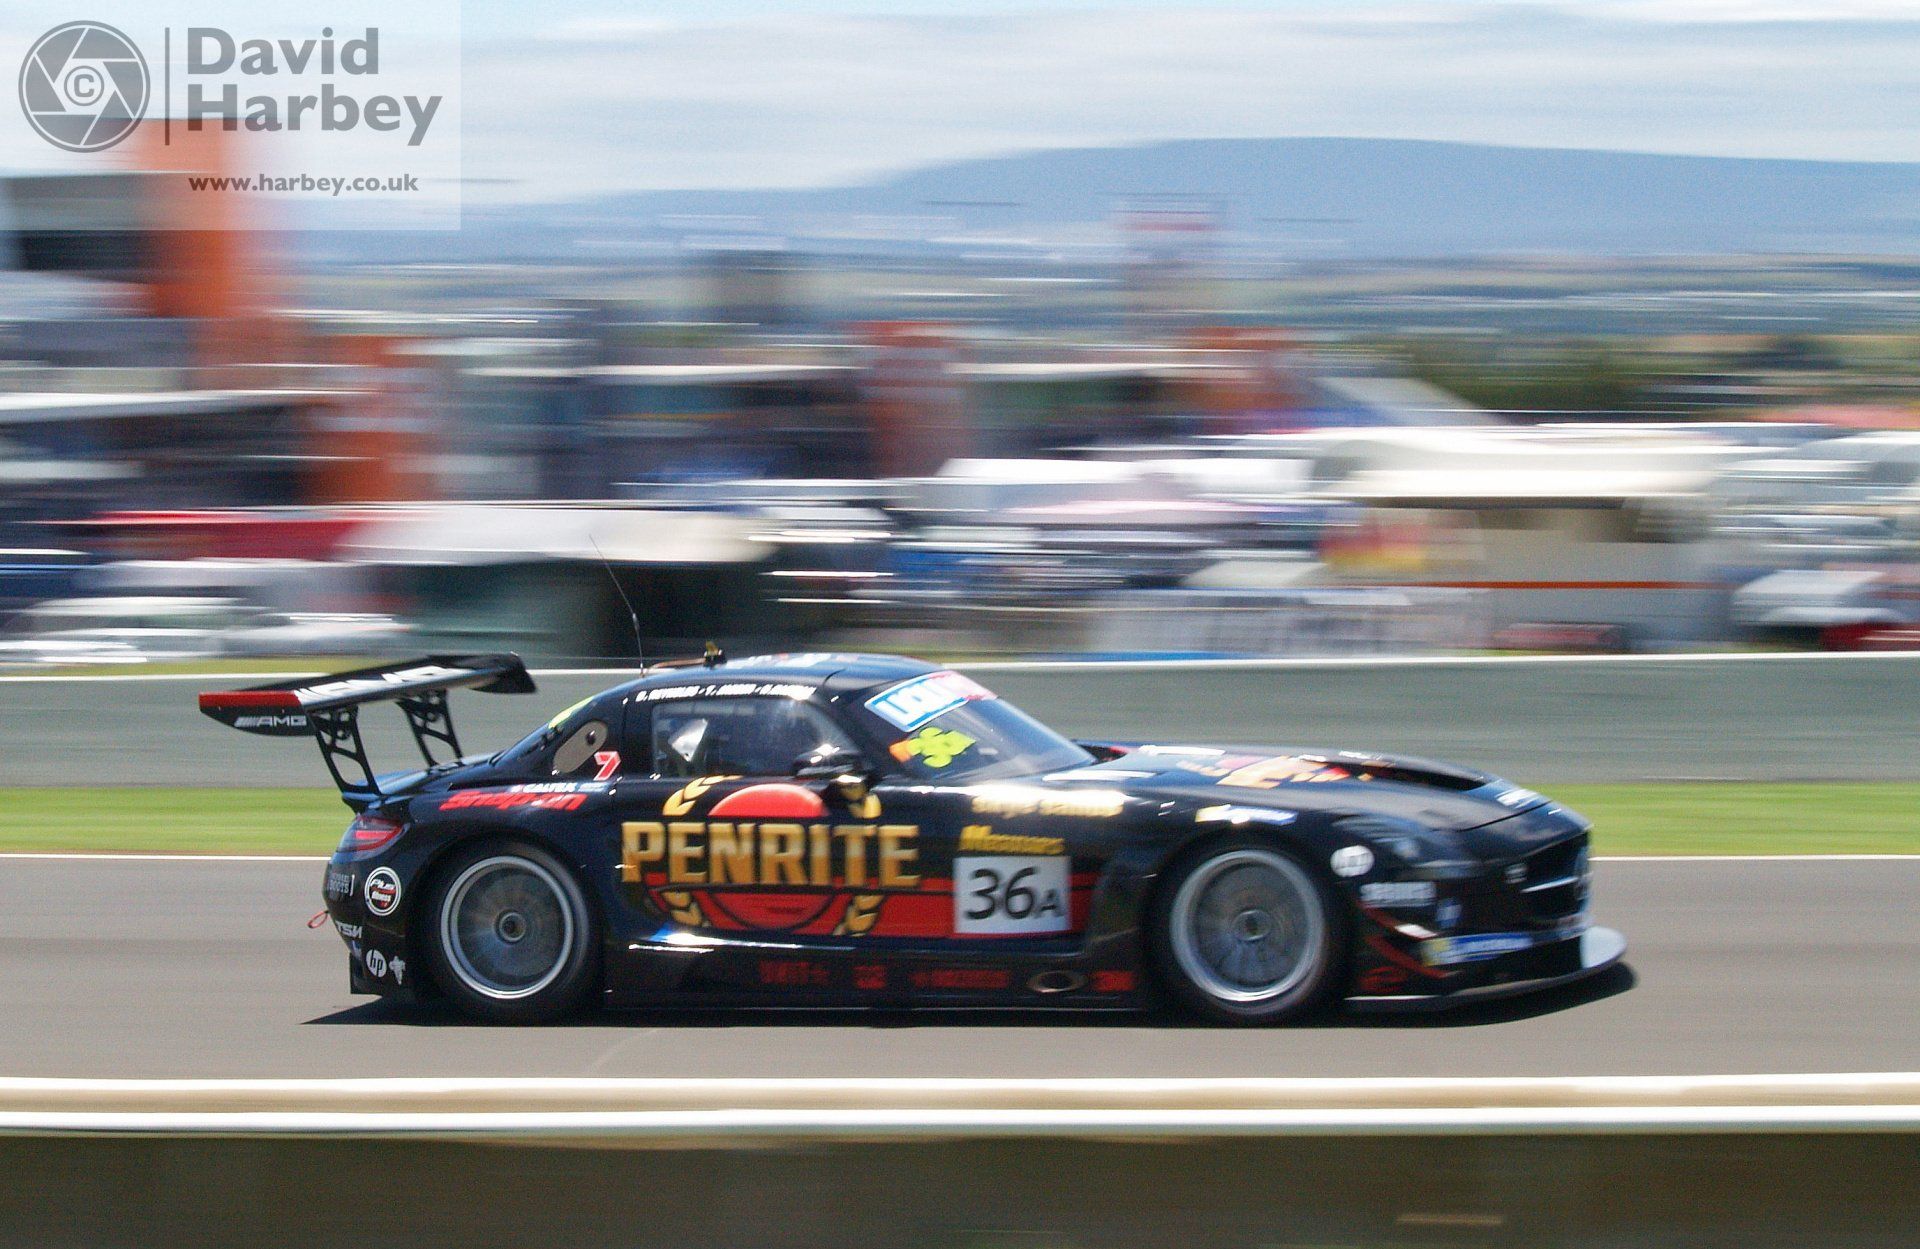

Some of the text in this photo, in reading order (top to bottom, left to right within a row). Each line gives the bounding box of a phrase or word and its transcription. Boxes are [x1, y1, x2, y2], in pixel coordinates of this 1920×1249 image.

[256, 715, 307, 727] AMG
[593, 751, 621, 781] 7
[621, 821, 921, 889] PENRITE
[965, 867, 1066, 920] 36A
[368, 949, 385, 977] hp
